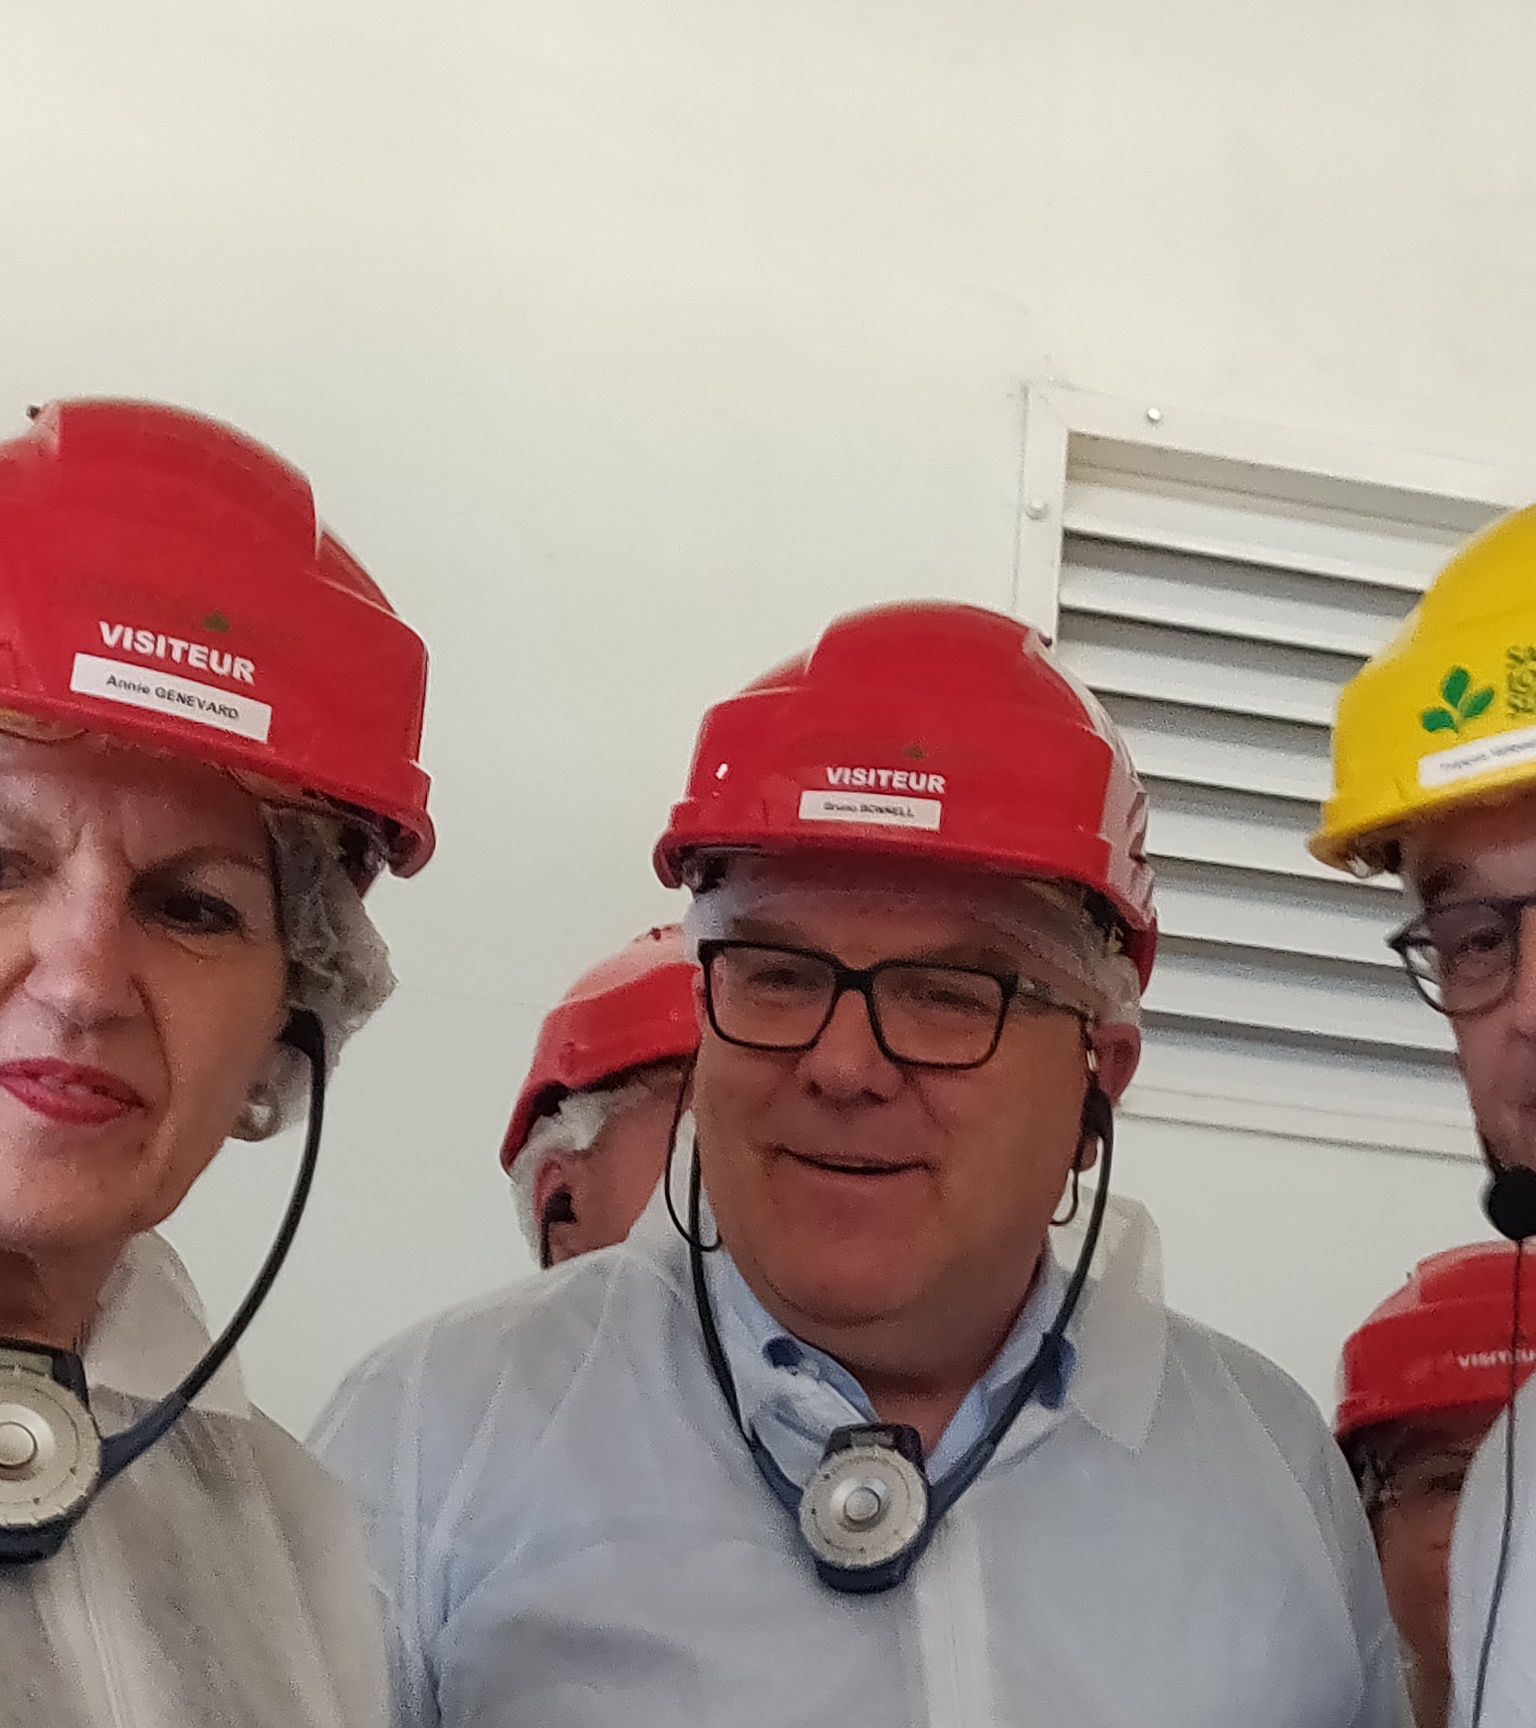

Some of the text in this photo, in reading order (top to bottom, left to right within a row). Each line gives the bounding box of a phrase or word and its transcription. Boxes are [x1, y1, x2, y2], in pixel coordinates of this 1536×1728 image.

[98, 621, 256, 686] VISITEUR
[106, 674, 240, 720] Annie GENEVARD
[826, 766, 946, 794] VISITEUR
